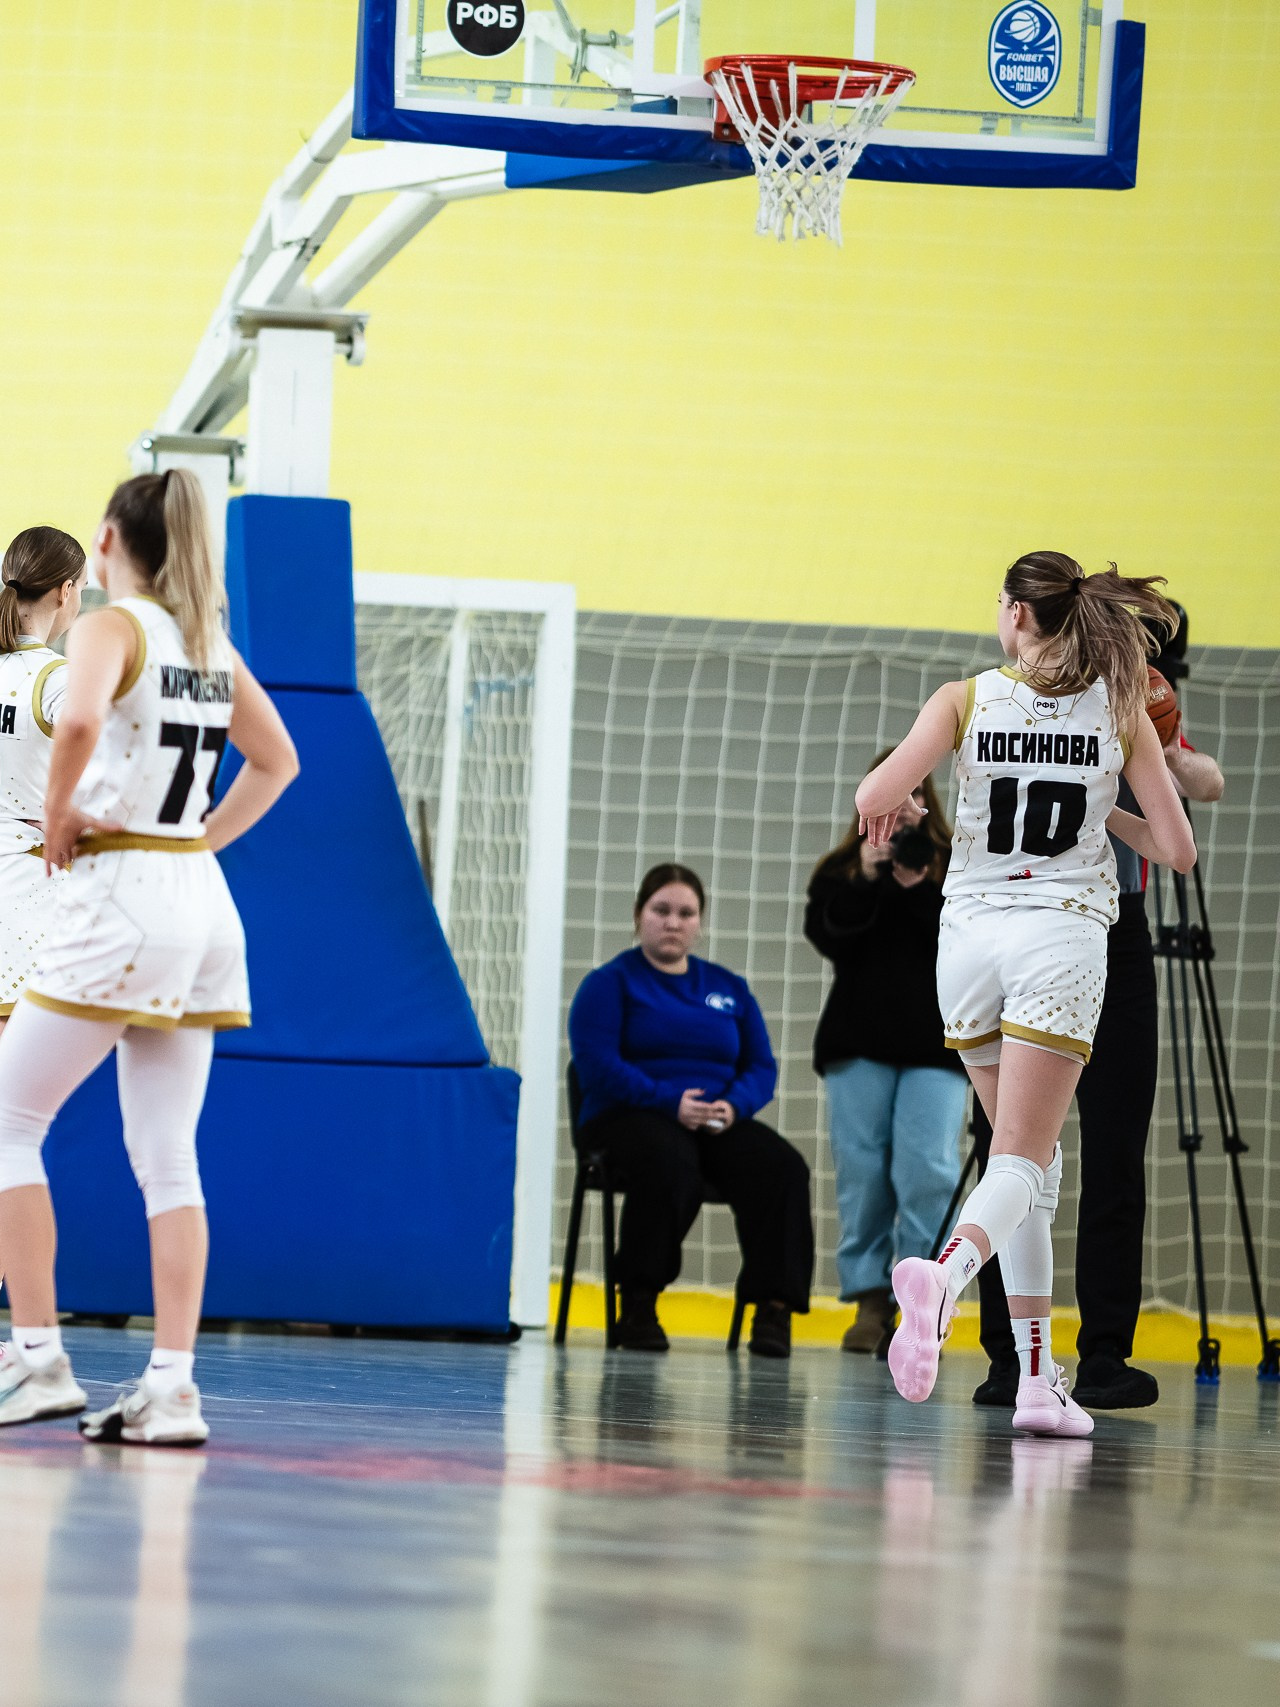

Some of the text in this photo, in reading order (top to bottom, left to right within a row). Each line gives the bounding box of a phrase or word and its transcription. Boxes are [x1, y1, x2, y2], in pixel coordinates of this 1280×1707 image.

[456, 2, 517, 29] РФБ
[1006, 53, 1044, 63] FONBET
[999, 64, 1049, 82] ВЫСШАЯ
[1015, 82, 1032, 92] ЛИГА
[1036, 701, 1056, 709] РФБ
[977, 731, 1100, 767] КОСИНОВА
[157, 721, 229, 824] 77
[986, 776, 1088, 858] 10
